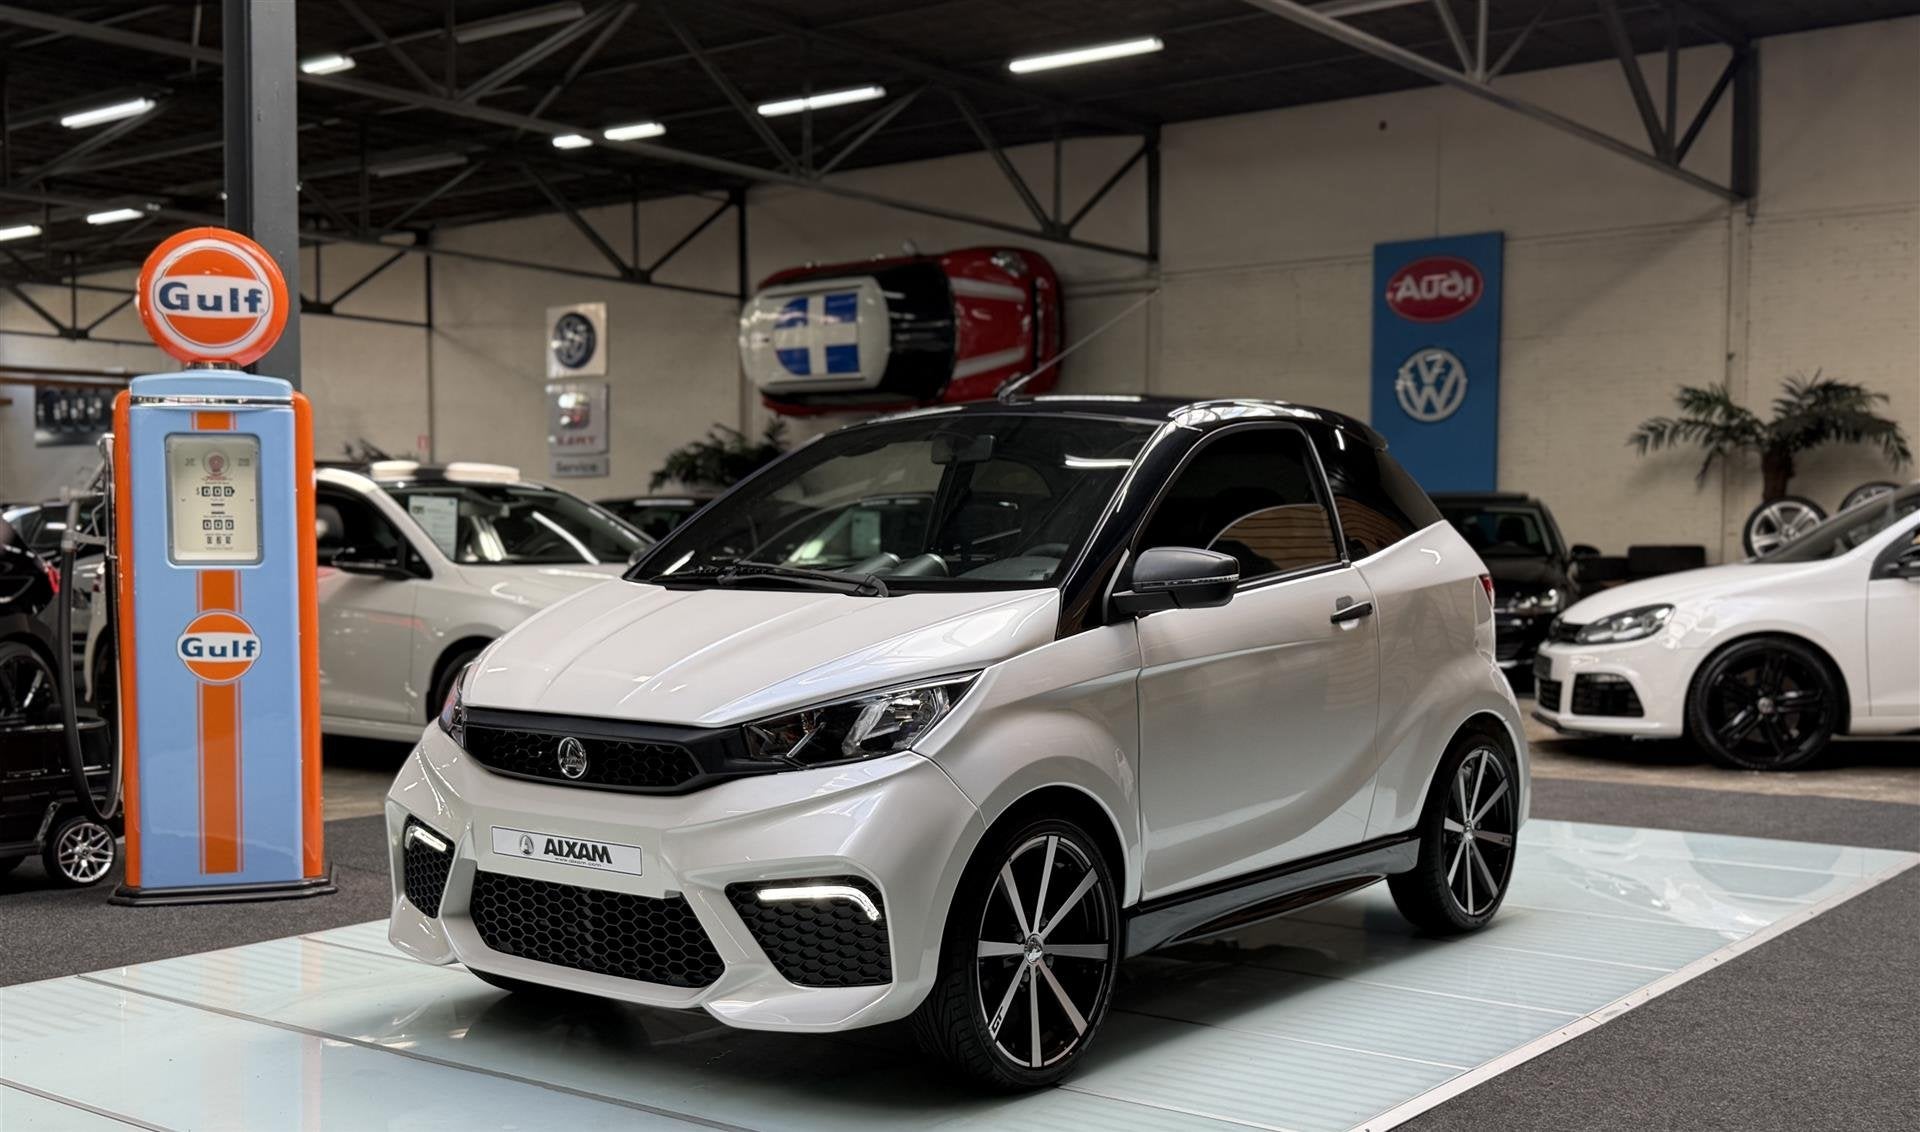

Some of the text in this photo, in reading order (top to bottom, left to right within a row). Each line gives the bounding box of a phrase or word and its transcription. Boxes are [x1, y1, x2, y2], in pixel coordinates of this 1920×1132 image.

[159, 281, 263, 313] Gulf
[181, 637, 257, 658] Gulf
[544, 838, 613, 865] AIXAM
